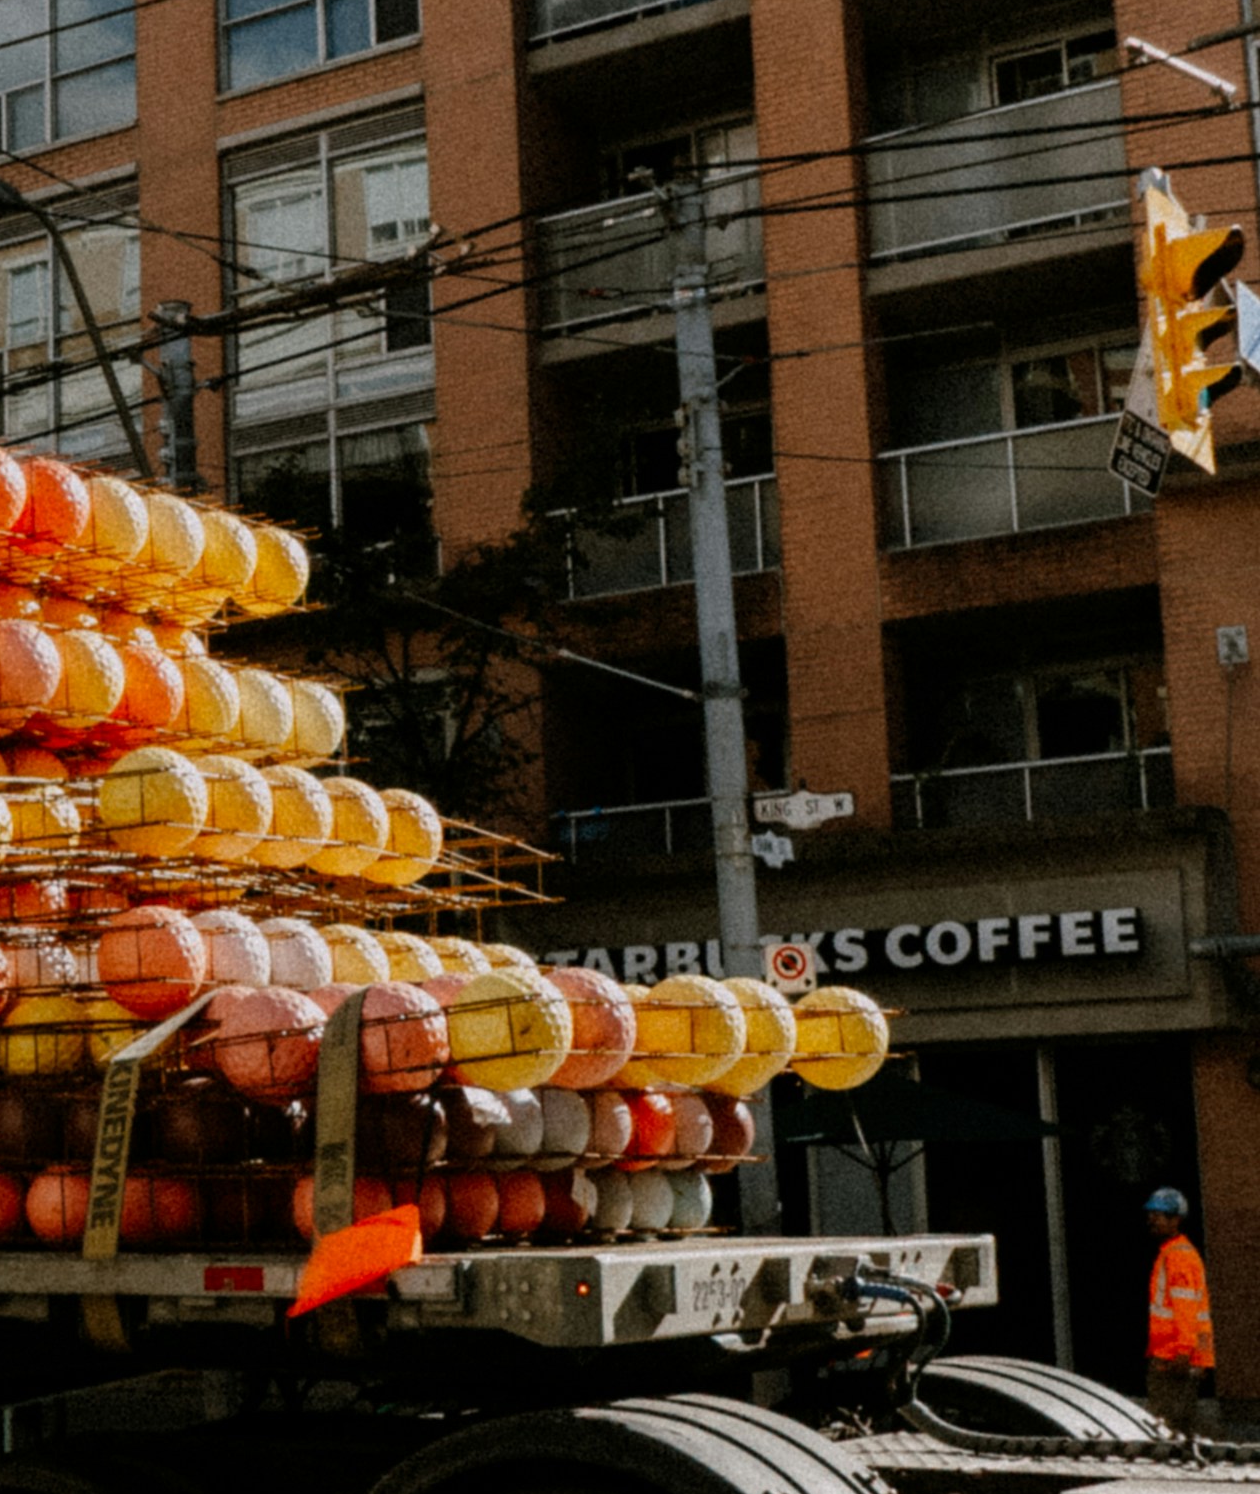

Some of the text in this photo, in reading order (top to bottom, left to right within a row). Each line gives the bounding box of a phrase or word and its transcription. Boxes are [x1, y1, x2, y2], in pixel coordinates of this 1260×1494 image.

[761, 798, 845, 817] KING ST W
[884, 907, 1140, 969] COFFEE
[92, 1060, 134, 1228] KINEDYNE
